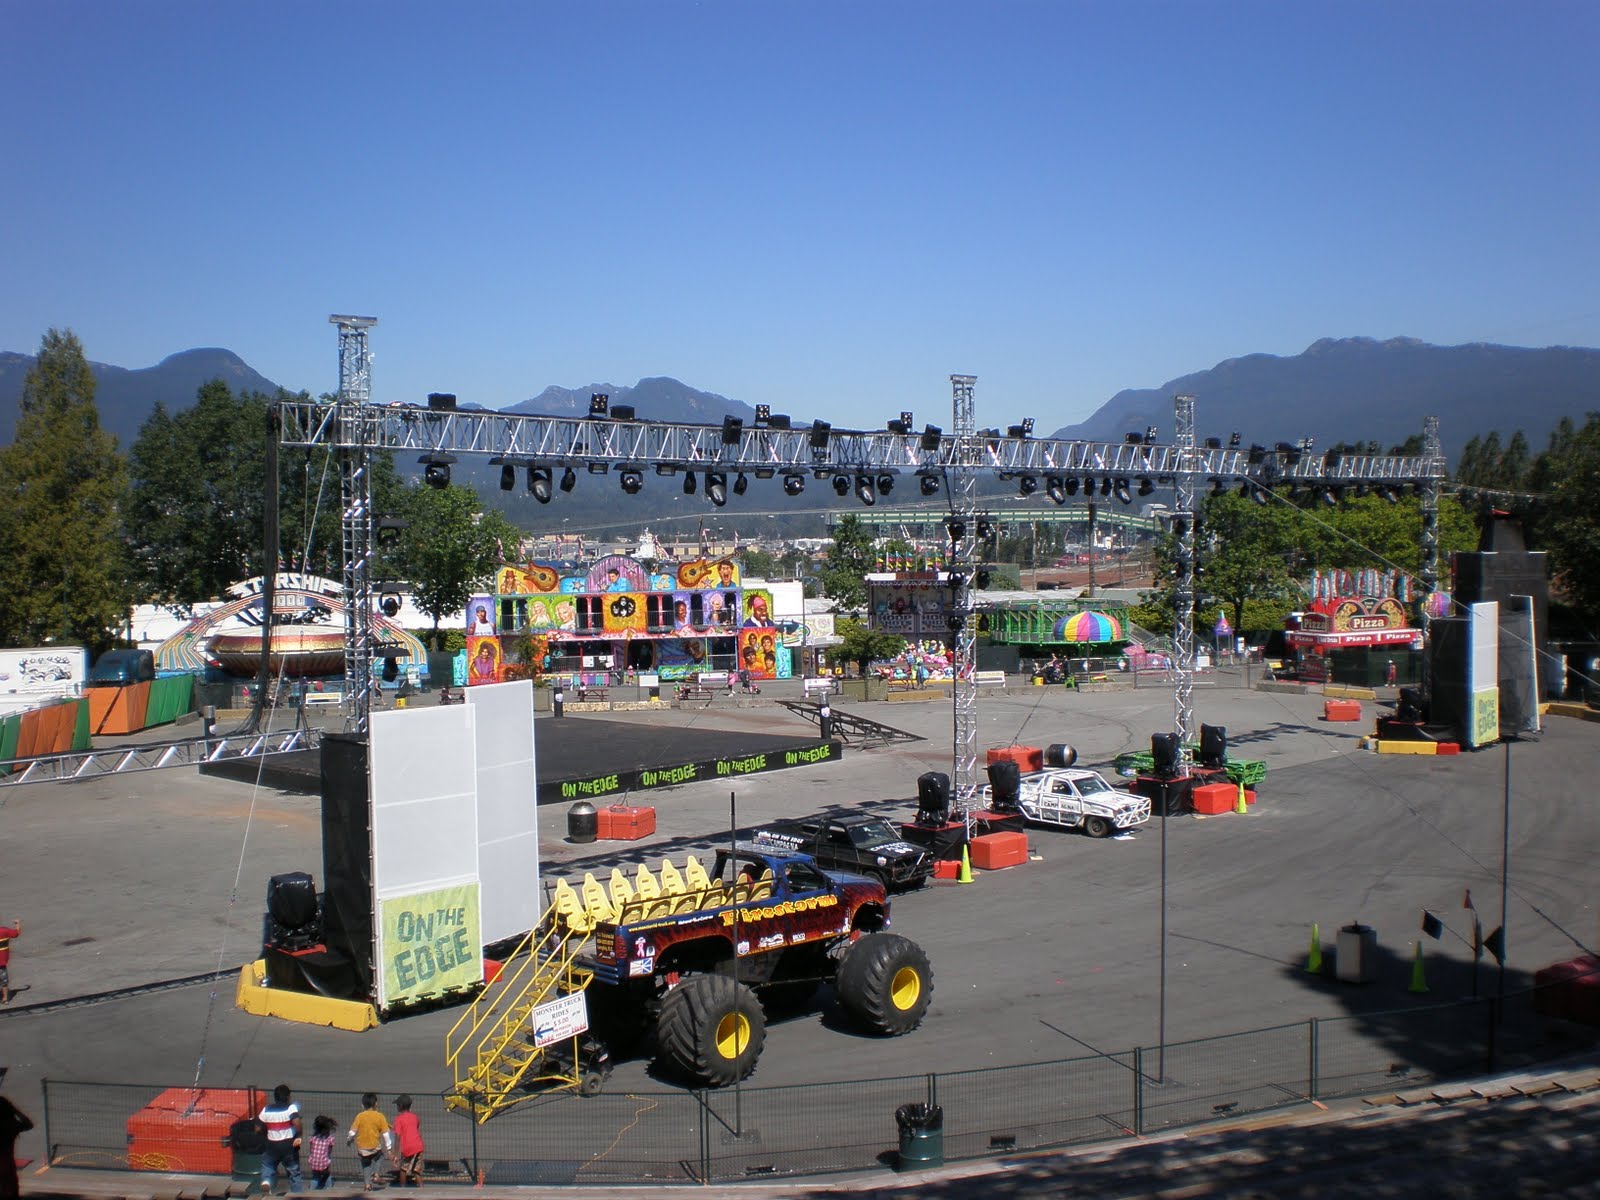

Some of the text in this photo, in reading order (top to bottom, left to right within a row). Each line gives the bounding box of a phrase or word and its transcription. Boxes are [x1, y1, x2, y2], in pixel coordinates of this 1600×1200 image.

[225, 573, 344, 598] STRSHIP
[1303, 618, 1325, 629] Pizza
[1353, 618, 1385, 629] Pizza
[717, 754, 766, 774] ON THE EDGE
[785, 744, 830, 764] ON THE EDGE
[642, 763, 696, 785] ON THE EDGE
[562, 774, 619, 797] ON THE EDGE
[719, 894, 838, 927] Firestorm
[397, 907, 465, 943] ON THE
[393, 927, 473, 992] EDGE
[535, 1003, 563, 1016] MONSTER
[564, 997, 582, 1007] TRUCK
[551, 1009, 569, 1019] RIDES
